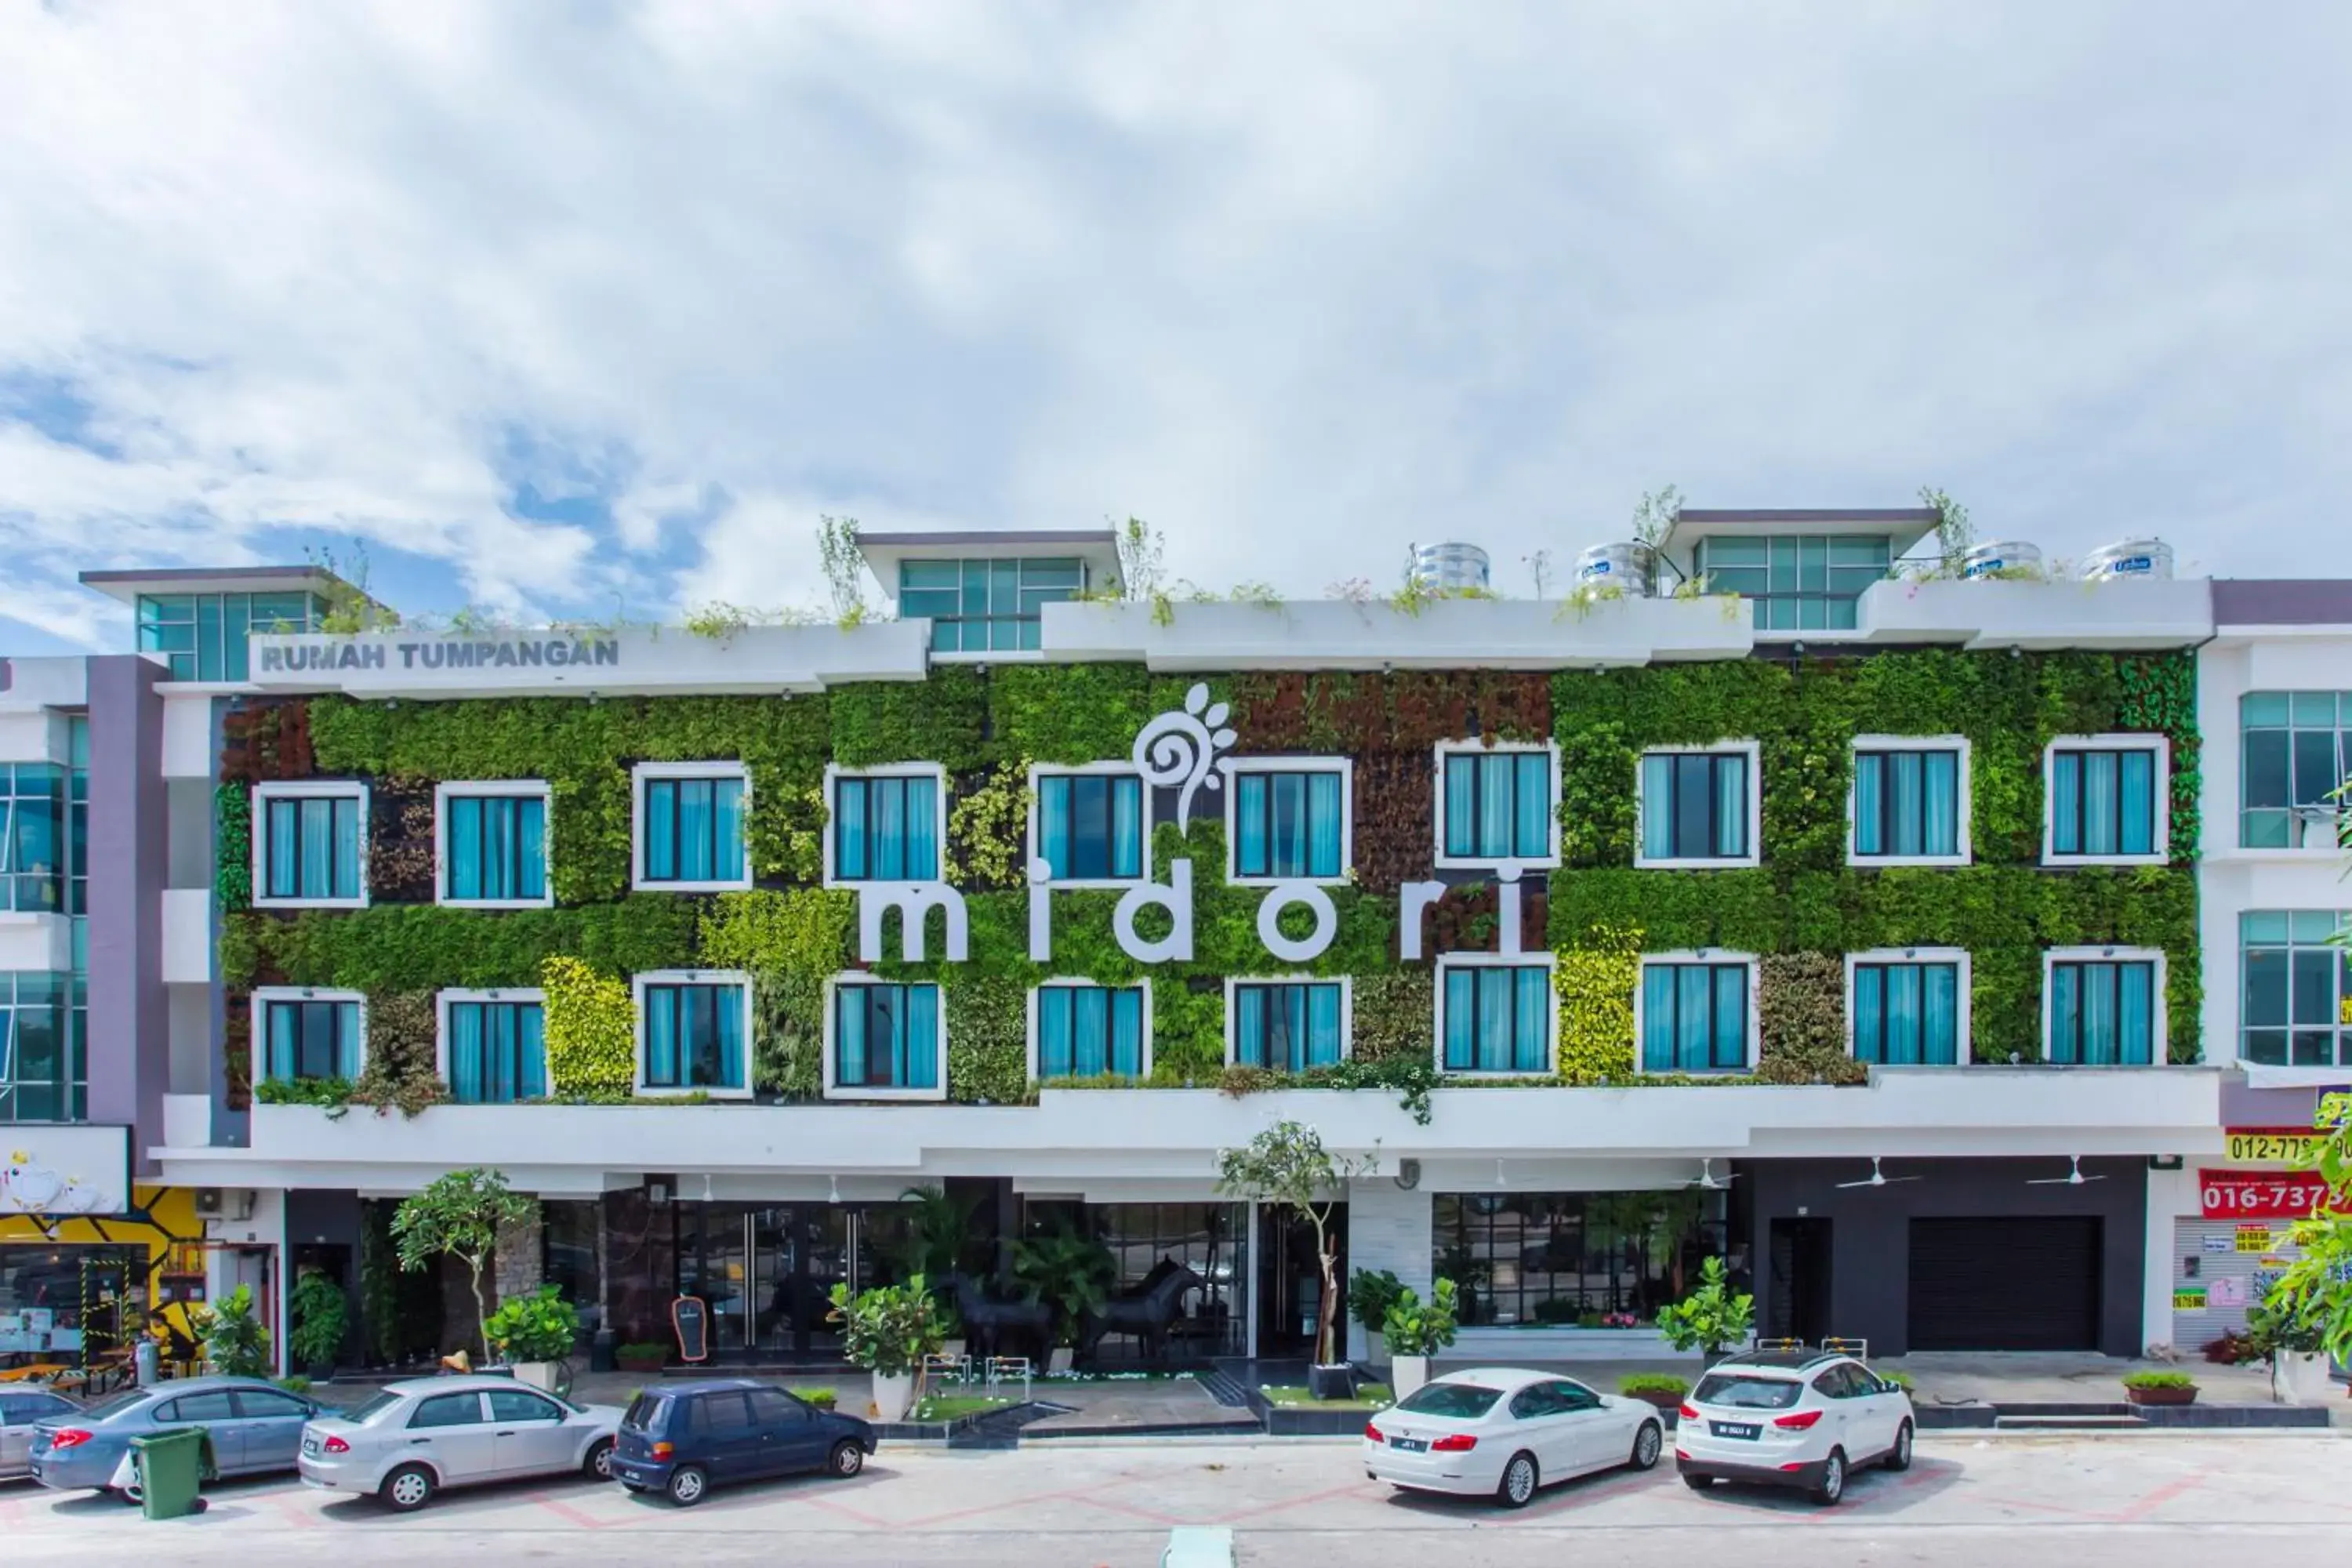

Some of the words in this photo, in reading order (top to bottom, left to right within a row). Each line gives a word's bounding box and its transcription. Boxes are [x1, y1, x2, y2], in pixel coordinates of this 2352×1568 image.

[262, 644, 384, 671] RUMAH
[397, 640, 619, 669] TUMPANGAN
[860, 858, 1523, 964] midori
